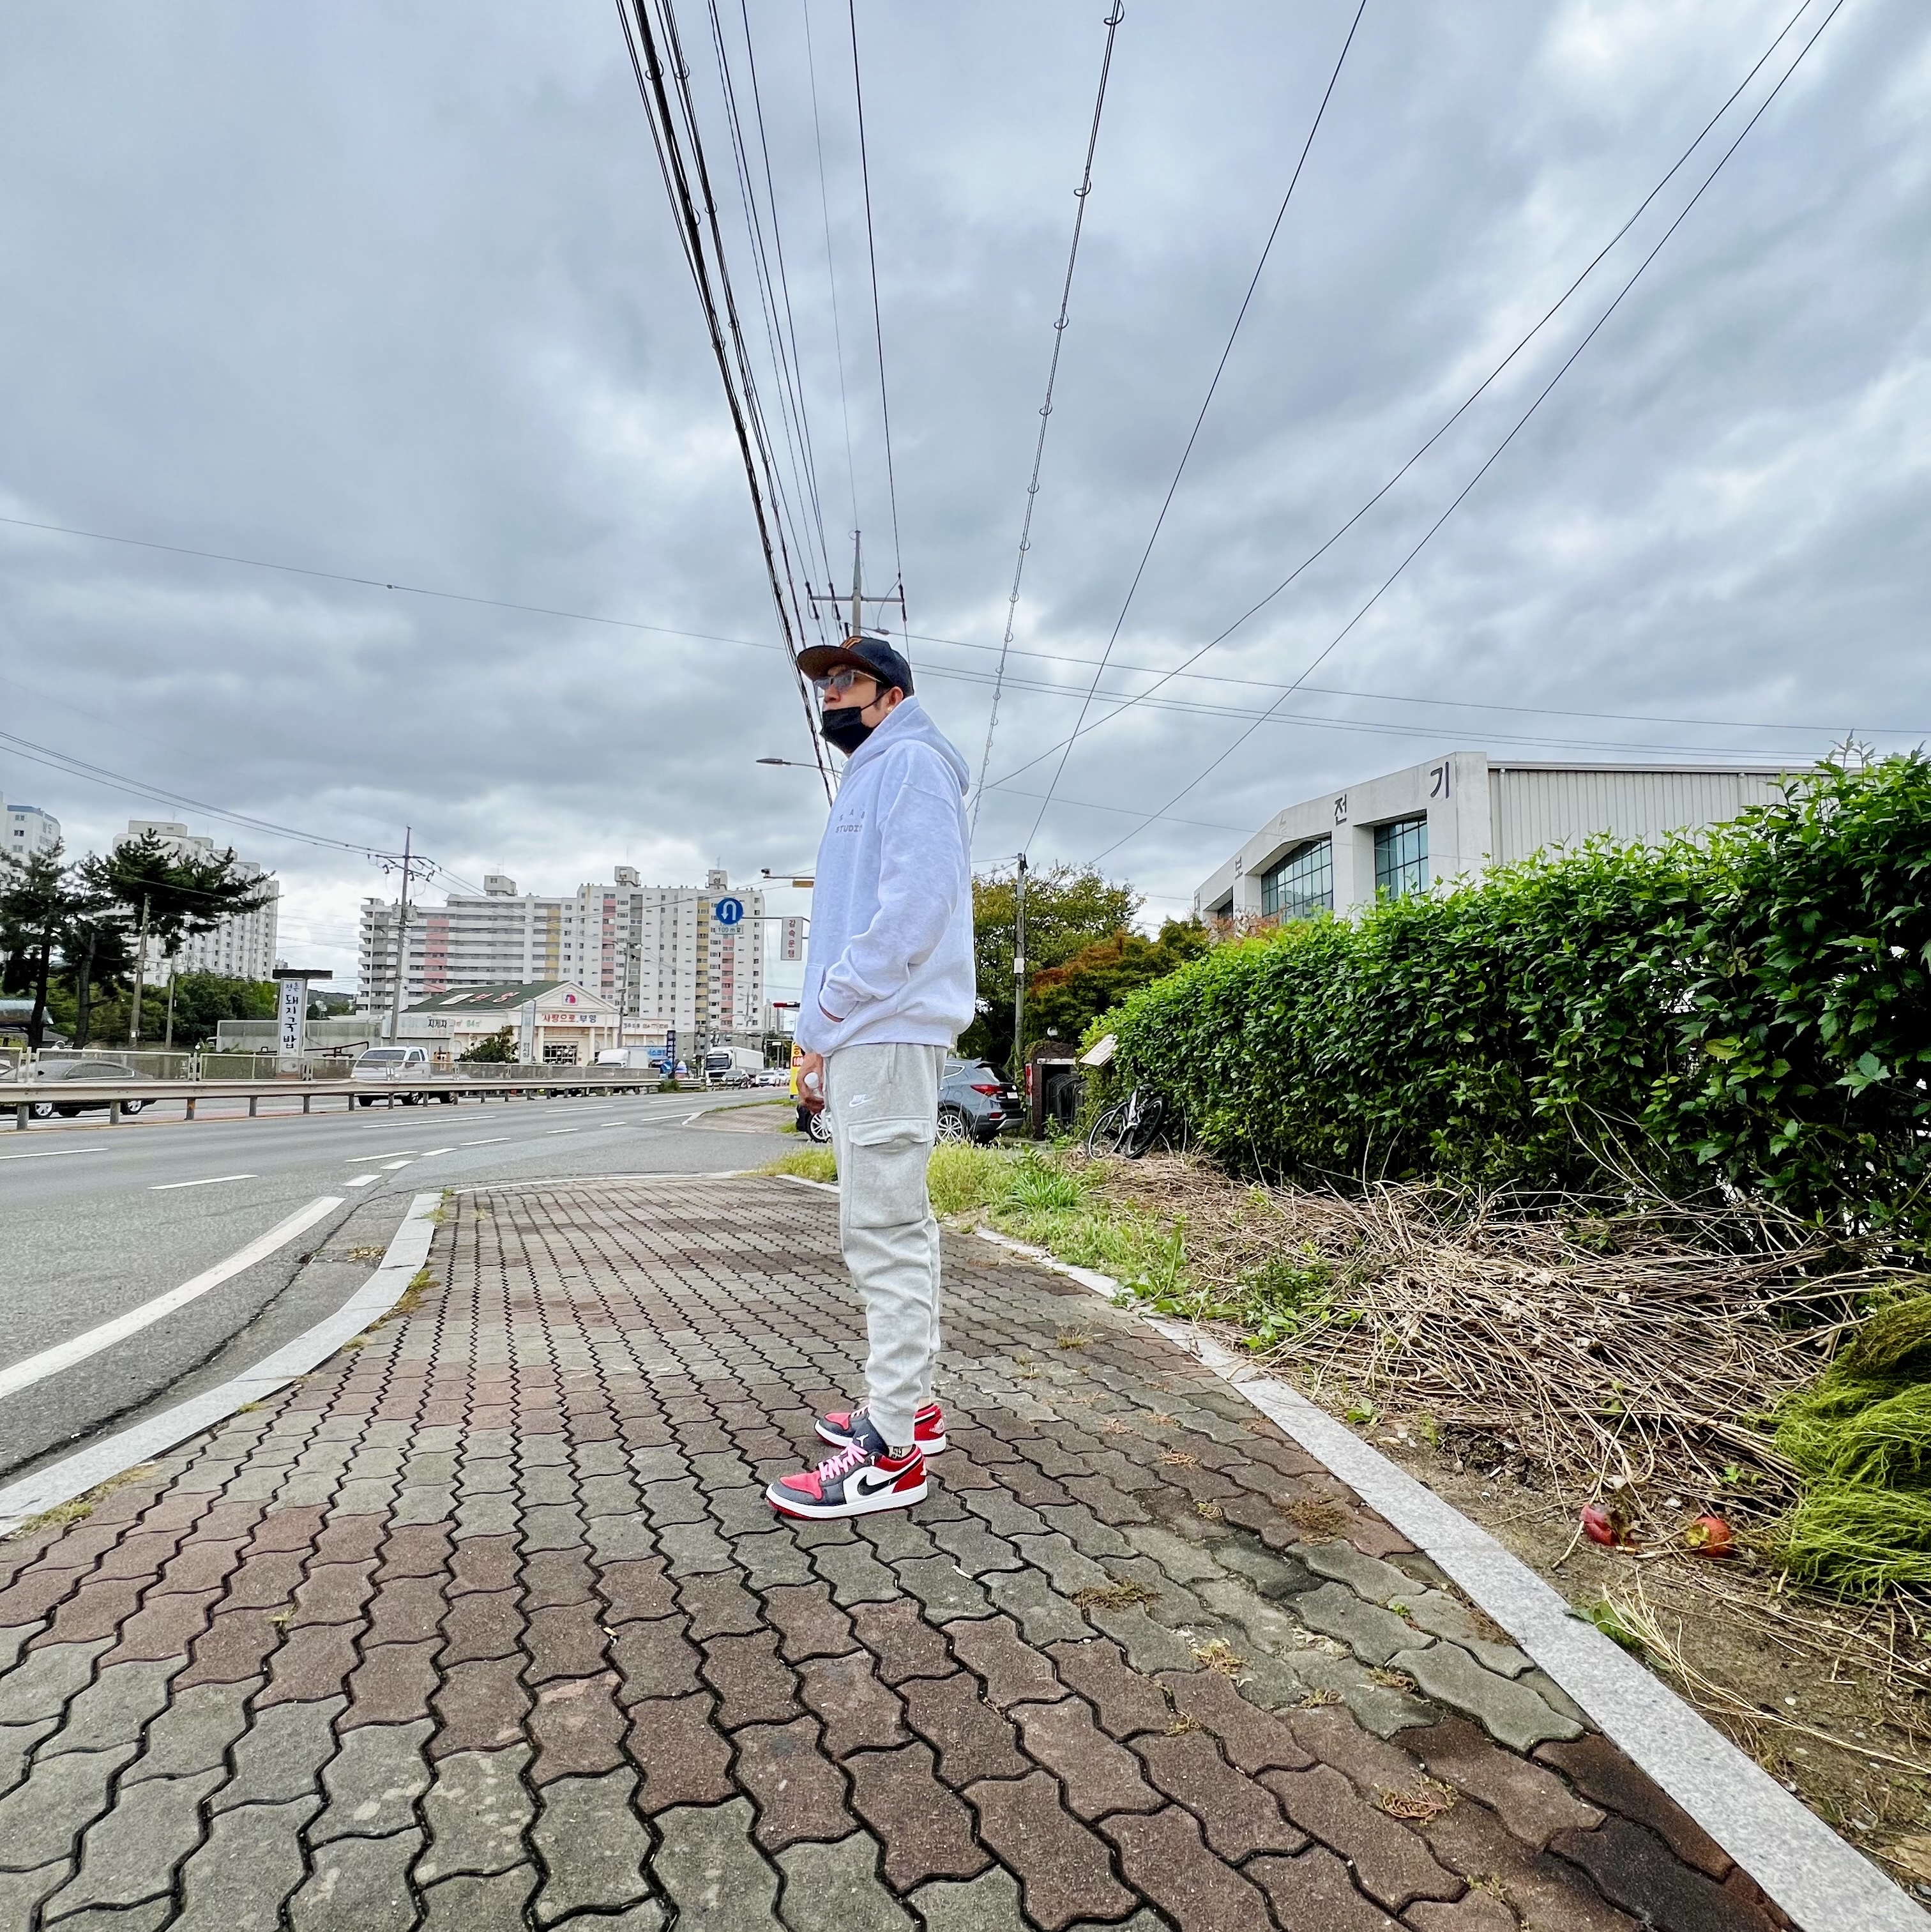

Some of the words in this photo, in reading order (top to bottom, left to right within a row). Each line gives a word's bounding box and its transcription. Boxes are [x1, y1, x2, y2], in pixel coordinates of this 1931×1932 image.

[787, 920, 796, 958] 감속운행
[283, 994, 298, 1049] 돼지국밥
[580, 1014, 597, 1023] 부영
